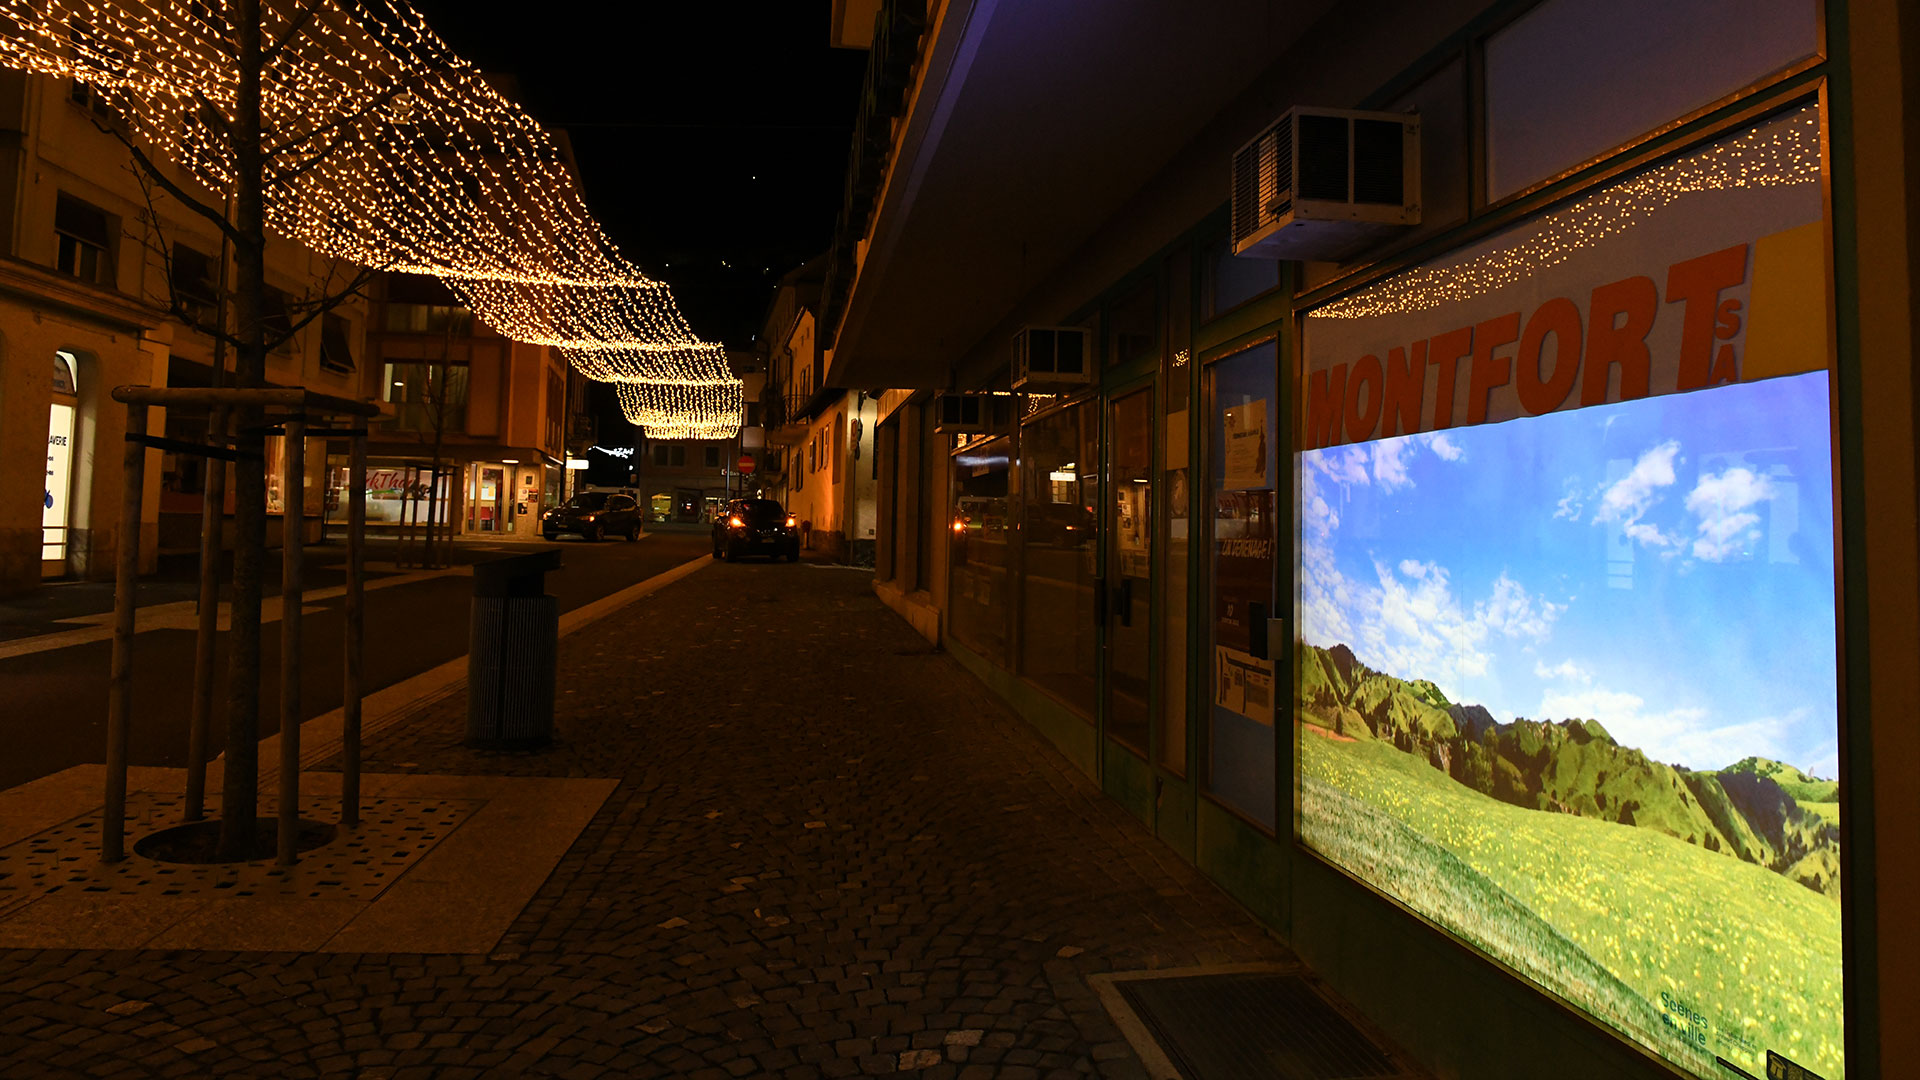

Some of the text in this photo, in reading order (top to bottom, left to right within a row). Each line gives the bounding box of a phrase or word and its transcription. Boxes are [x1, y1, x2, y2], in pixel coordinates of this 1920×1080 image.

[1306, 243, 1748, 449] MONTFORT
[1661, 991, 1708, 1029] Scènes
[1662, 1013, 1678, 1031] en
[1680, 1021, 1707, 1046] ville
